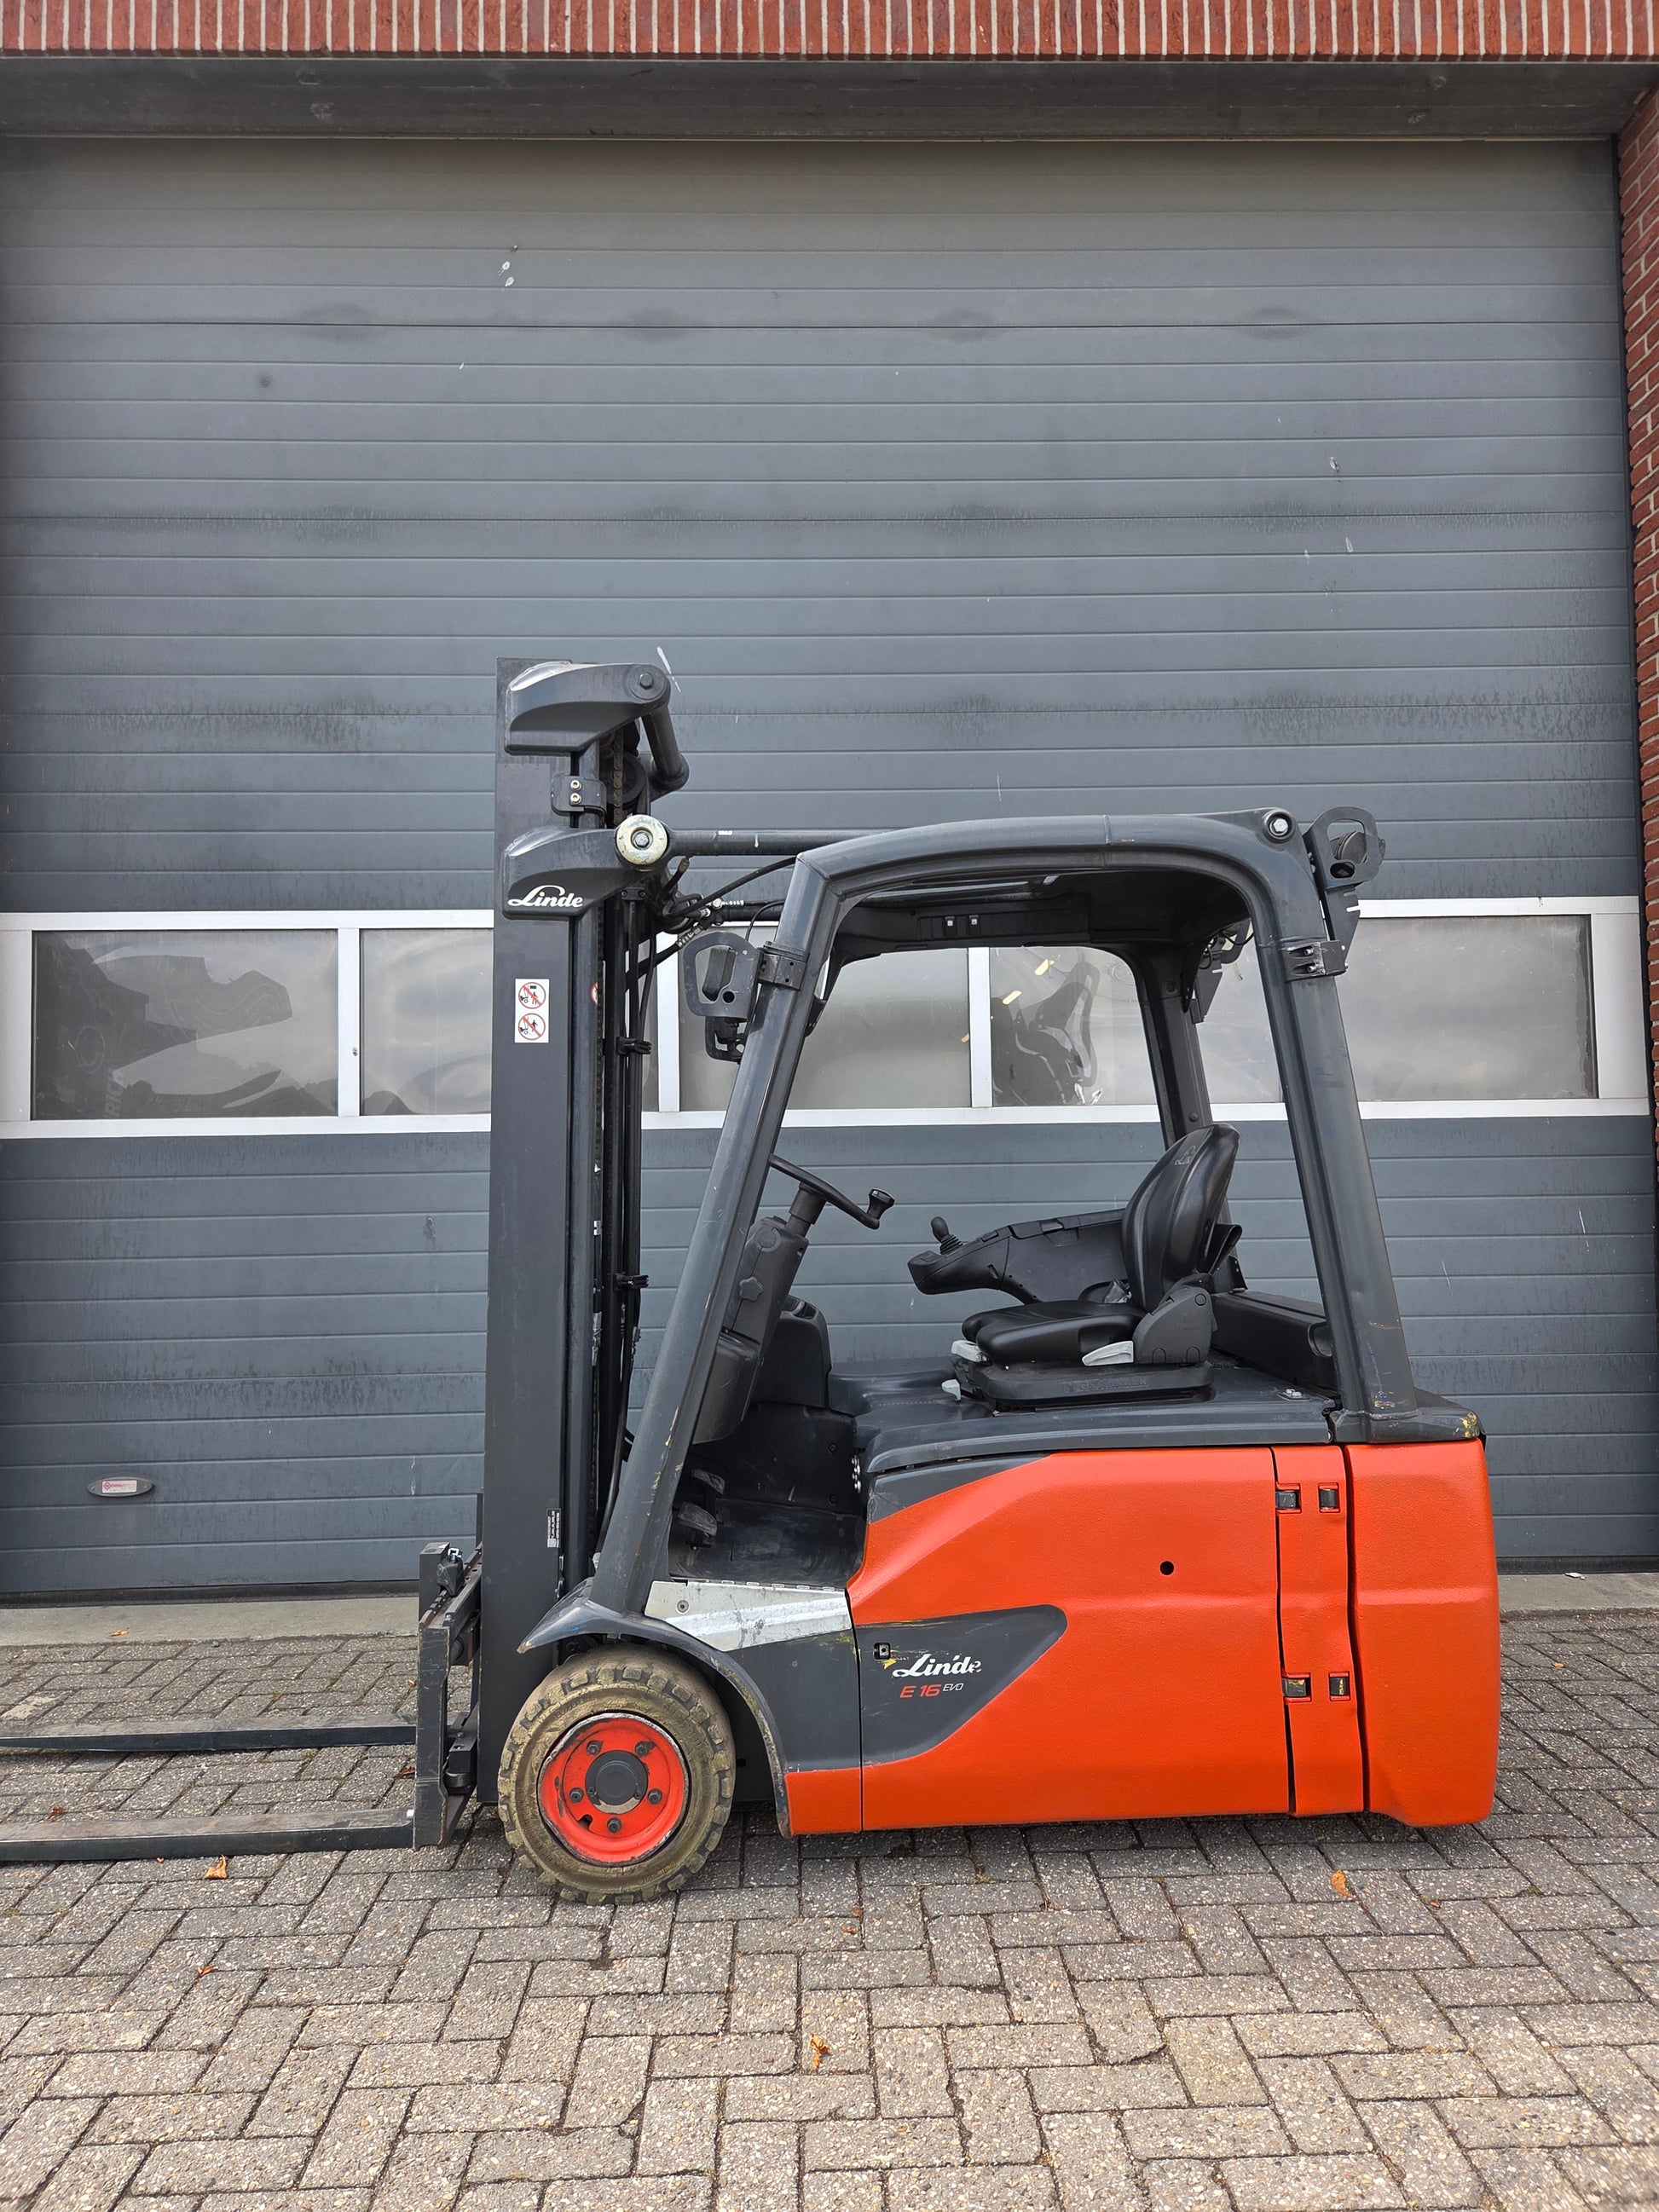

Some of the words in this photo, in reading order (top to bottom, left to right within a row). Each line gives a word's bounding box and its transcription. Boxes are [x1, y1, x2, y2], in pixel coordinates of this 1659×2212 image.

[507, 885, 584, 908] Linde
[892, 1653, 982, 1678] Linde
[943, 1683, 964, 1692] EVO
